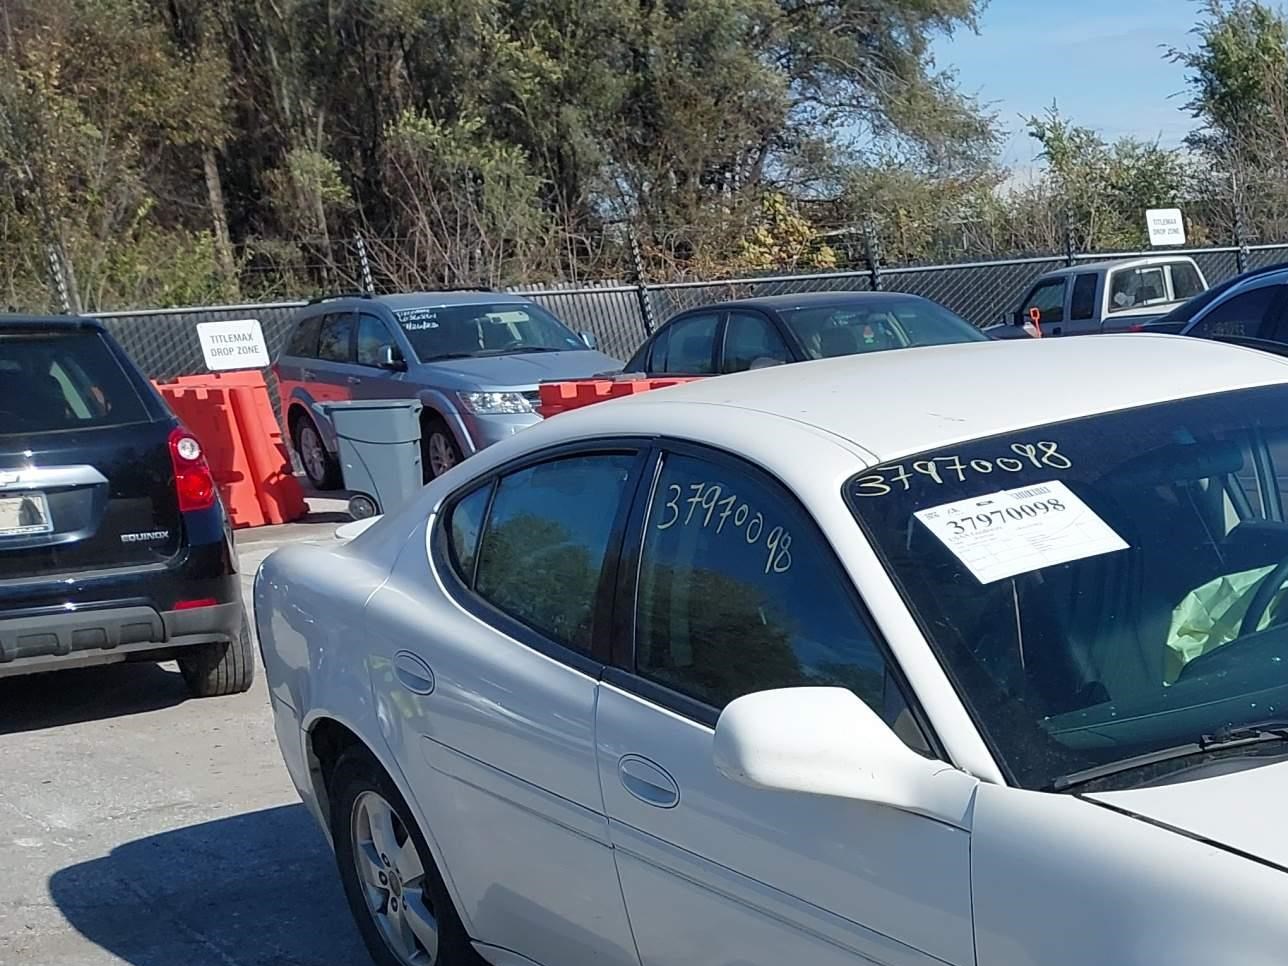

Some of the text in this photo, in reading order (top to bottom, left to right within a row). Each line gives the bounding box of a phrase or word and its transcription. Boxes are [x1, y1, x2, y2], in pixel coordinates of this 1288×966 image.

[209, 332, 254, 344] TITLEMAX
[210, 344, 261, 357] DROP ZONE
[855, 441, 1072, 497] 37970098
[657, 483, 792, 574] 37970098
[946, 498, 1066, 535] 37970098
[120, 530, 169, 542] EQUINOX
